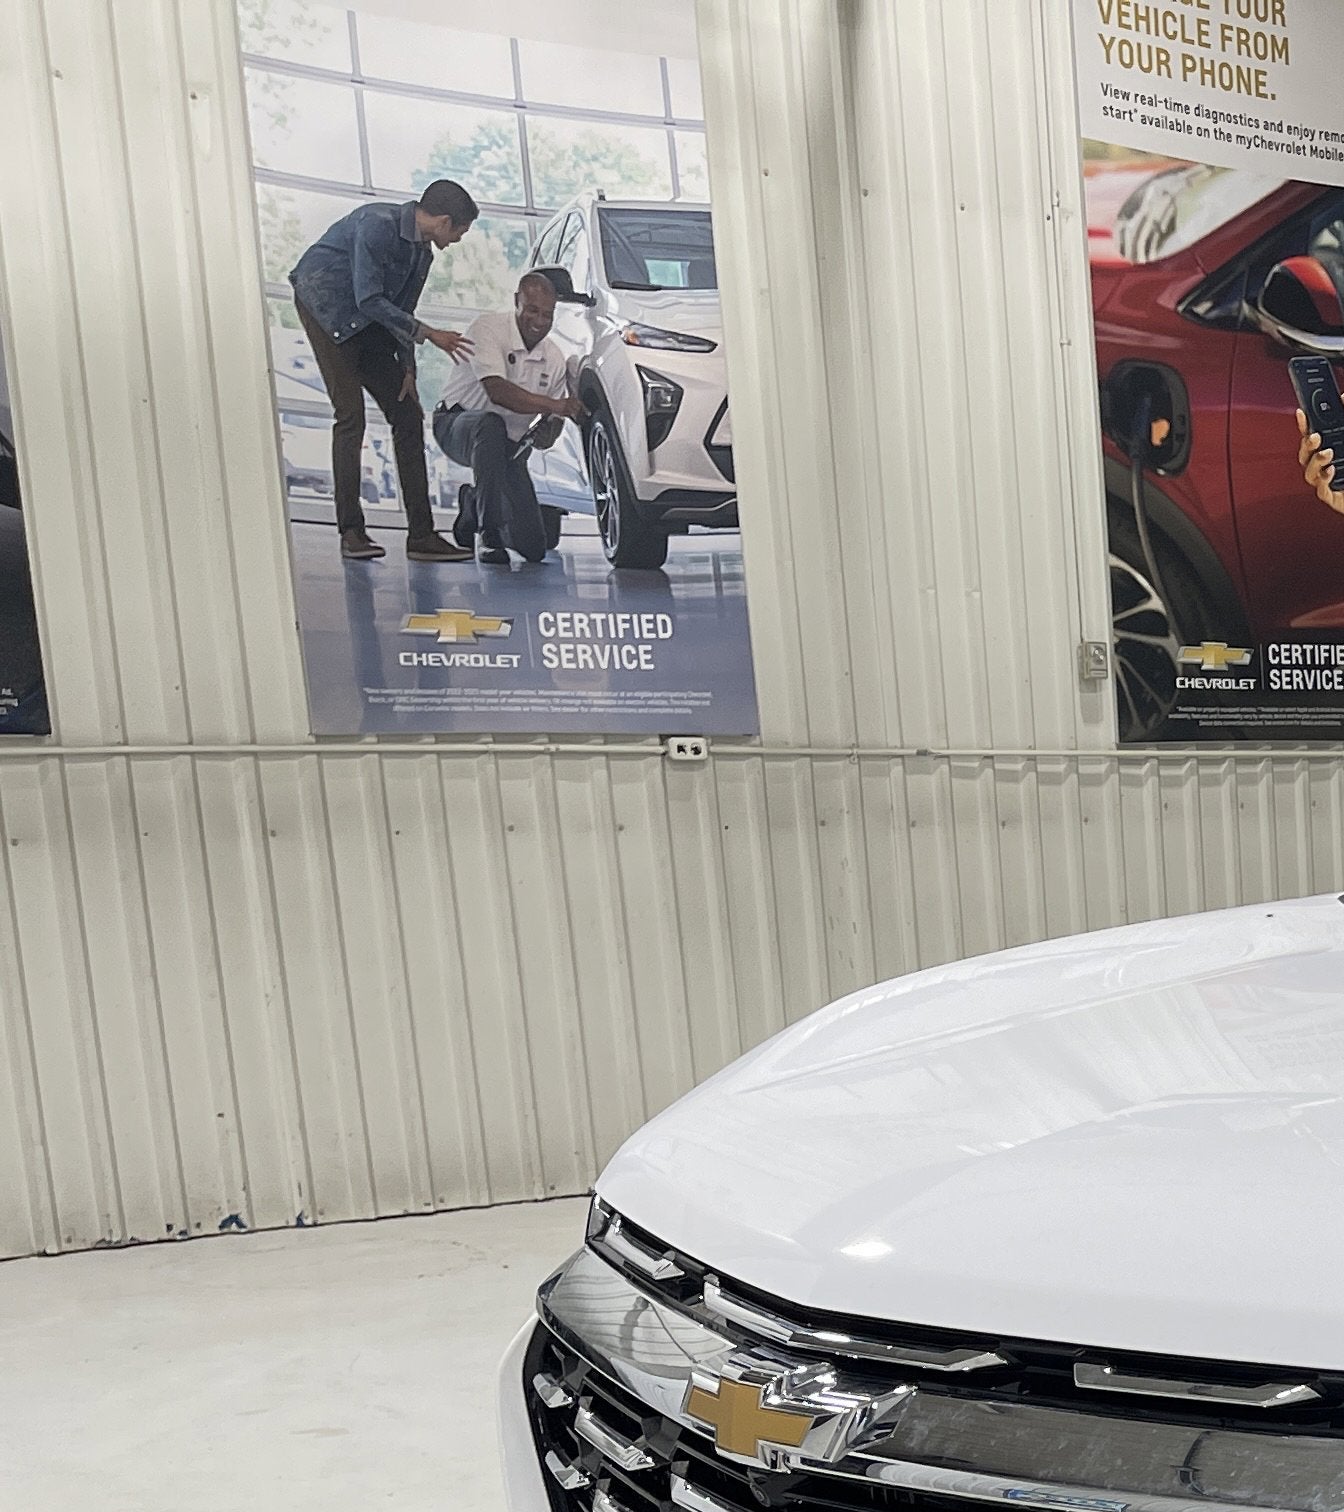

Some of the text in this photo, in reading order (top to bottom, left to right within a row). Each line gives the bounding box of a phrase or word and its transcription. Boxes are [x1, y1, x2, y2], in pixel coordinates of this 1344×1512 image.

[1097, 0, 1290, 65] VEHICLE FROM
[1098, 33, 1276, 100] YOUR PHONE.
[1100, 82, 1131, 101] View
[1134, 91, 1190, 116] real-time
[1194, 103, 1259, 130] diagnostics
[1263, 118, 1283, 134] and
[1287, 123, 1316, 142] enjoy
[1141, 112, 1193, 135] available
[1196, 126, 1210, 139] on
[1213, 128, 1233, 143] the
[1236, 133, 1306, 156] myChevrolet
[1309, 145, 1344, 163] Mobile
[538, 611, 673, 639] CERTIFIED
[399, 652, 521, 668] CHEVROLET
[542, 643, 655, 670] SERVICE
[1175, 677, 1257, 690] CHEVROLET
[1269, 668, 1344, 691] SERVICE
